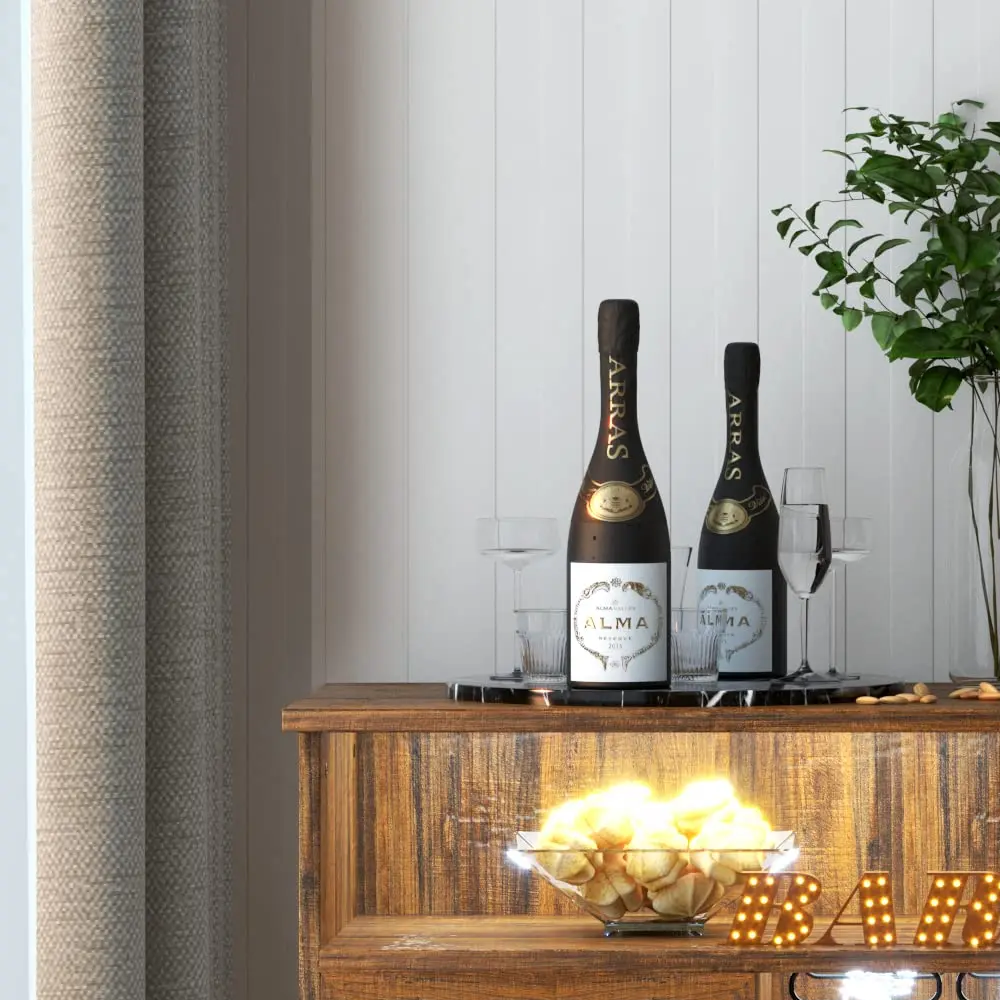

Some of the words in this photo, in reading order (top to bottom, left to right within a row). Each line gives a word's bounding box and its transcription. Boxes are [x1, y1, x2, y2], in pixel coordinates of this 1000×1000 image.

[607, 355, 629, 460] ARRAS
[725, 392, 742, 480] ARRAS
[584, 616, 648, 630] ALMA
